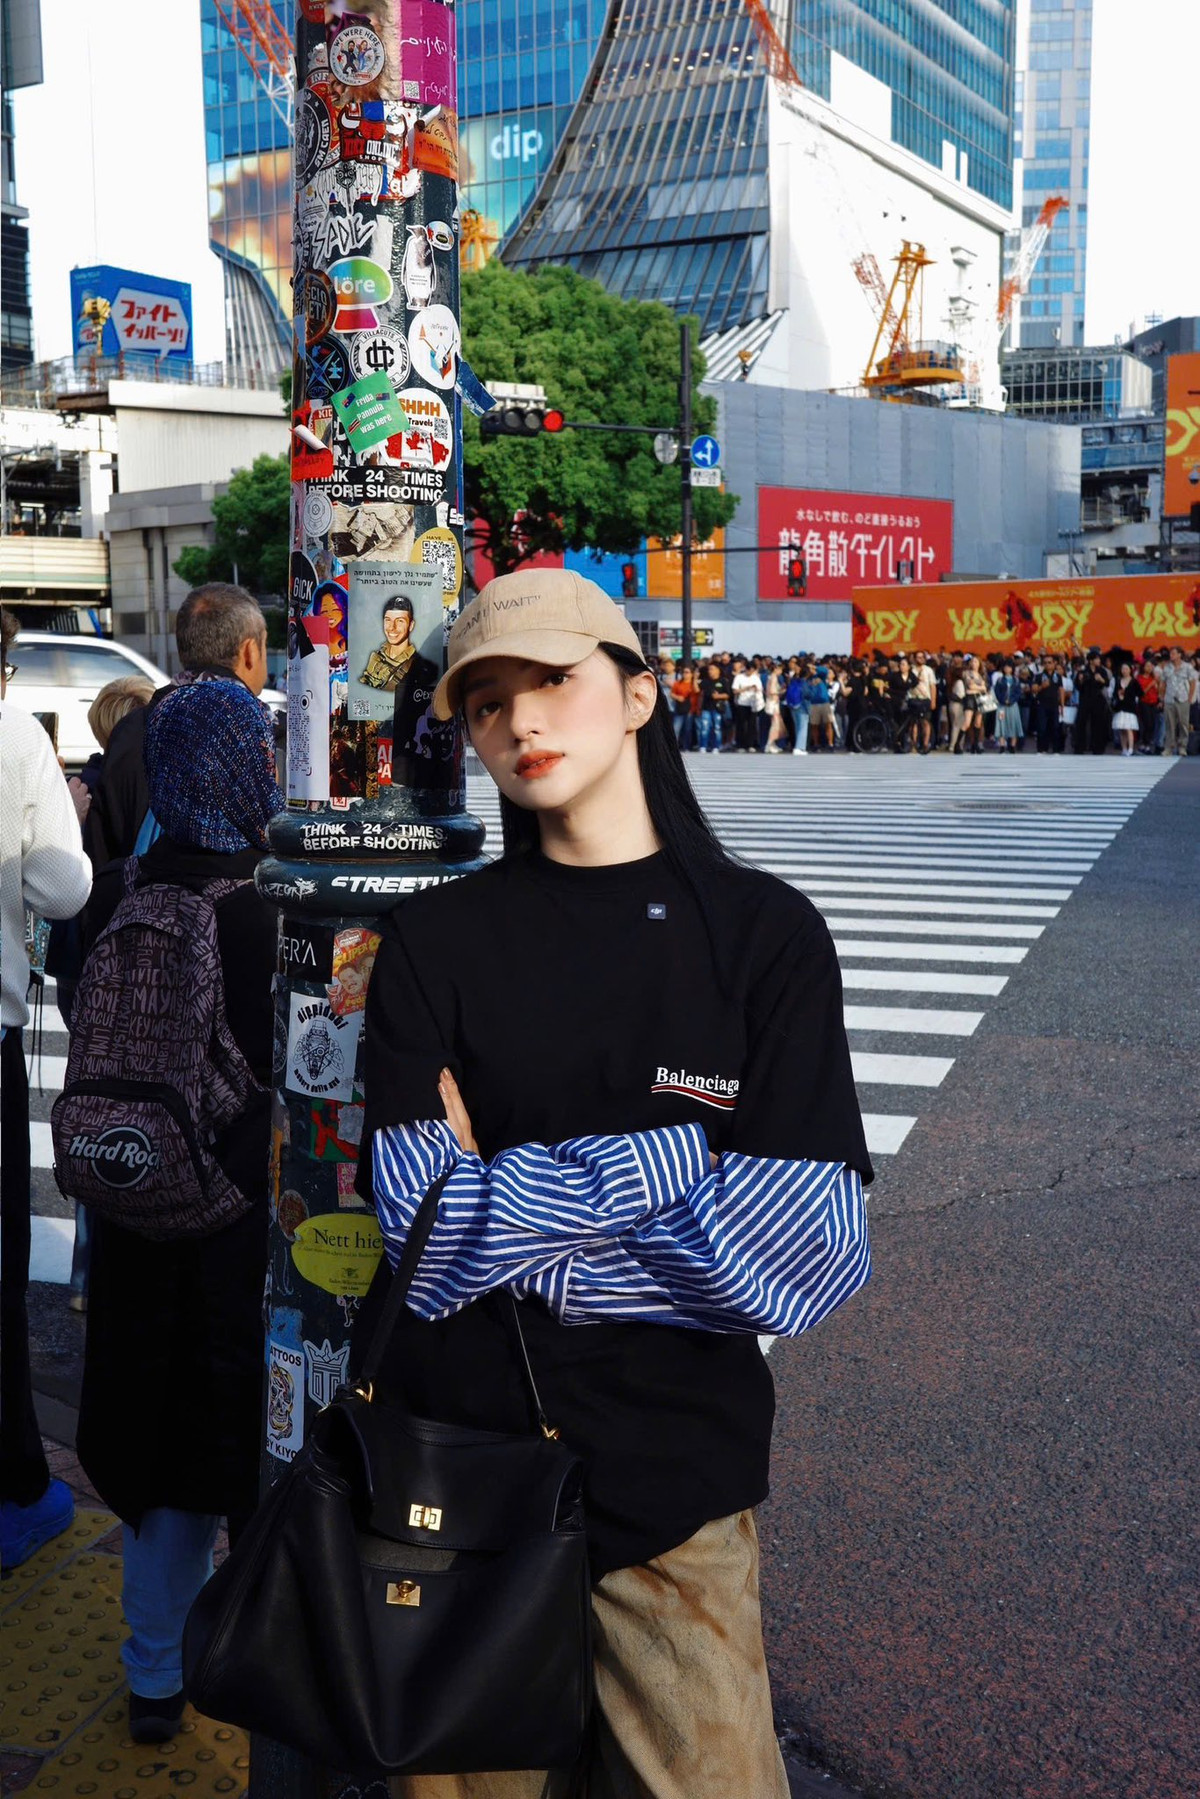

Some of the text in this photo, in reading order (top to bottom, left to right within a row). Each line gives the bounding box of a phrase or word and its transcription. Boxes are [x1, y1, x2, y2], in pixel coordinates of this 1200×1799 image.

[343, 29, 363, 38] WERE
[364, 32, 380, 46] HERE
[320, 119, 330, 148] CAEN
[490, 124, 543, 162] dip
[334, 276, 376, 295] löre
[120, 299, 178, 323] ファイト
[355, 392, 375, 408] Frida
[359, 413, 392, 434] was here
[408, 417, 433, 427] Travels
[365, 469, 385, 483] 24
[403, 470, 443, 488] TIMES
[366, 485, 442, 501] SHOOTING
[304, 823, 444, 840] THINK 24 TIMES
[303, 836, 360, 851] BEFORE
[81, 1007, 116, 1028] RAGUE
[129, 1015, 151, 1038] KEY
[126, 1040, 158, 1056] SANTA
[81, 1055, 123, 1079] MUMBAI
[124, 1054, 155, 1073] CRUZ
[655, 1066, 740, 1095] Balenciaga
[64, 1104, 108, 1127] PRAGUE
[68, 1134, 123, 1161] Hard
[313, 1227, 350, 1248] Nett
